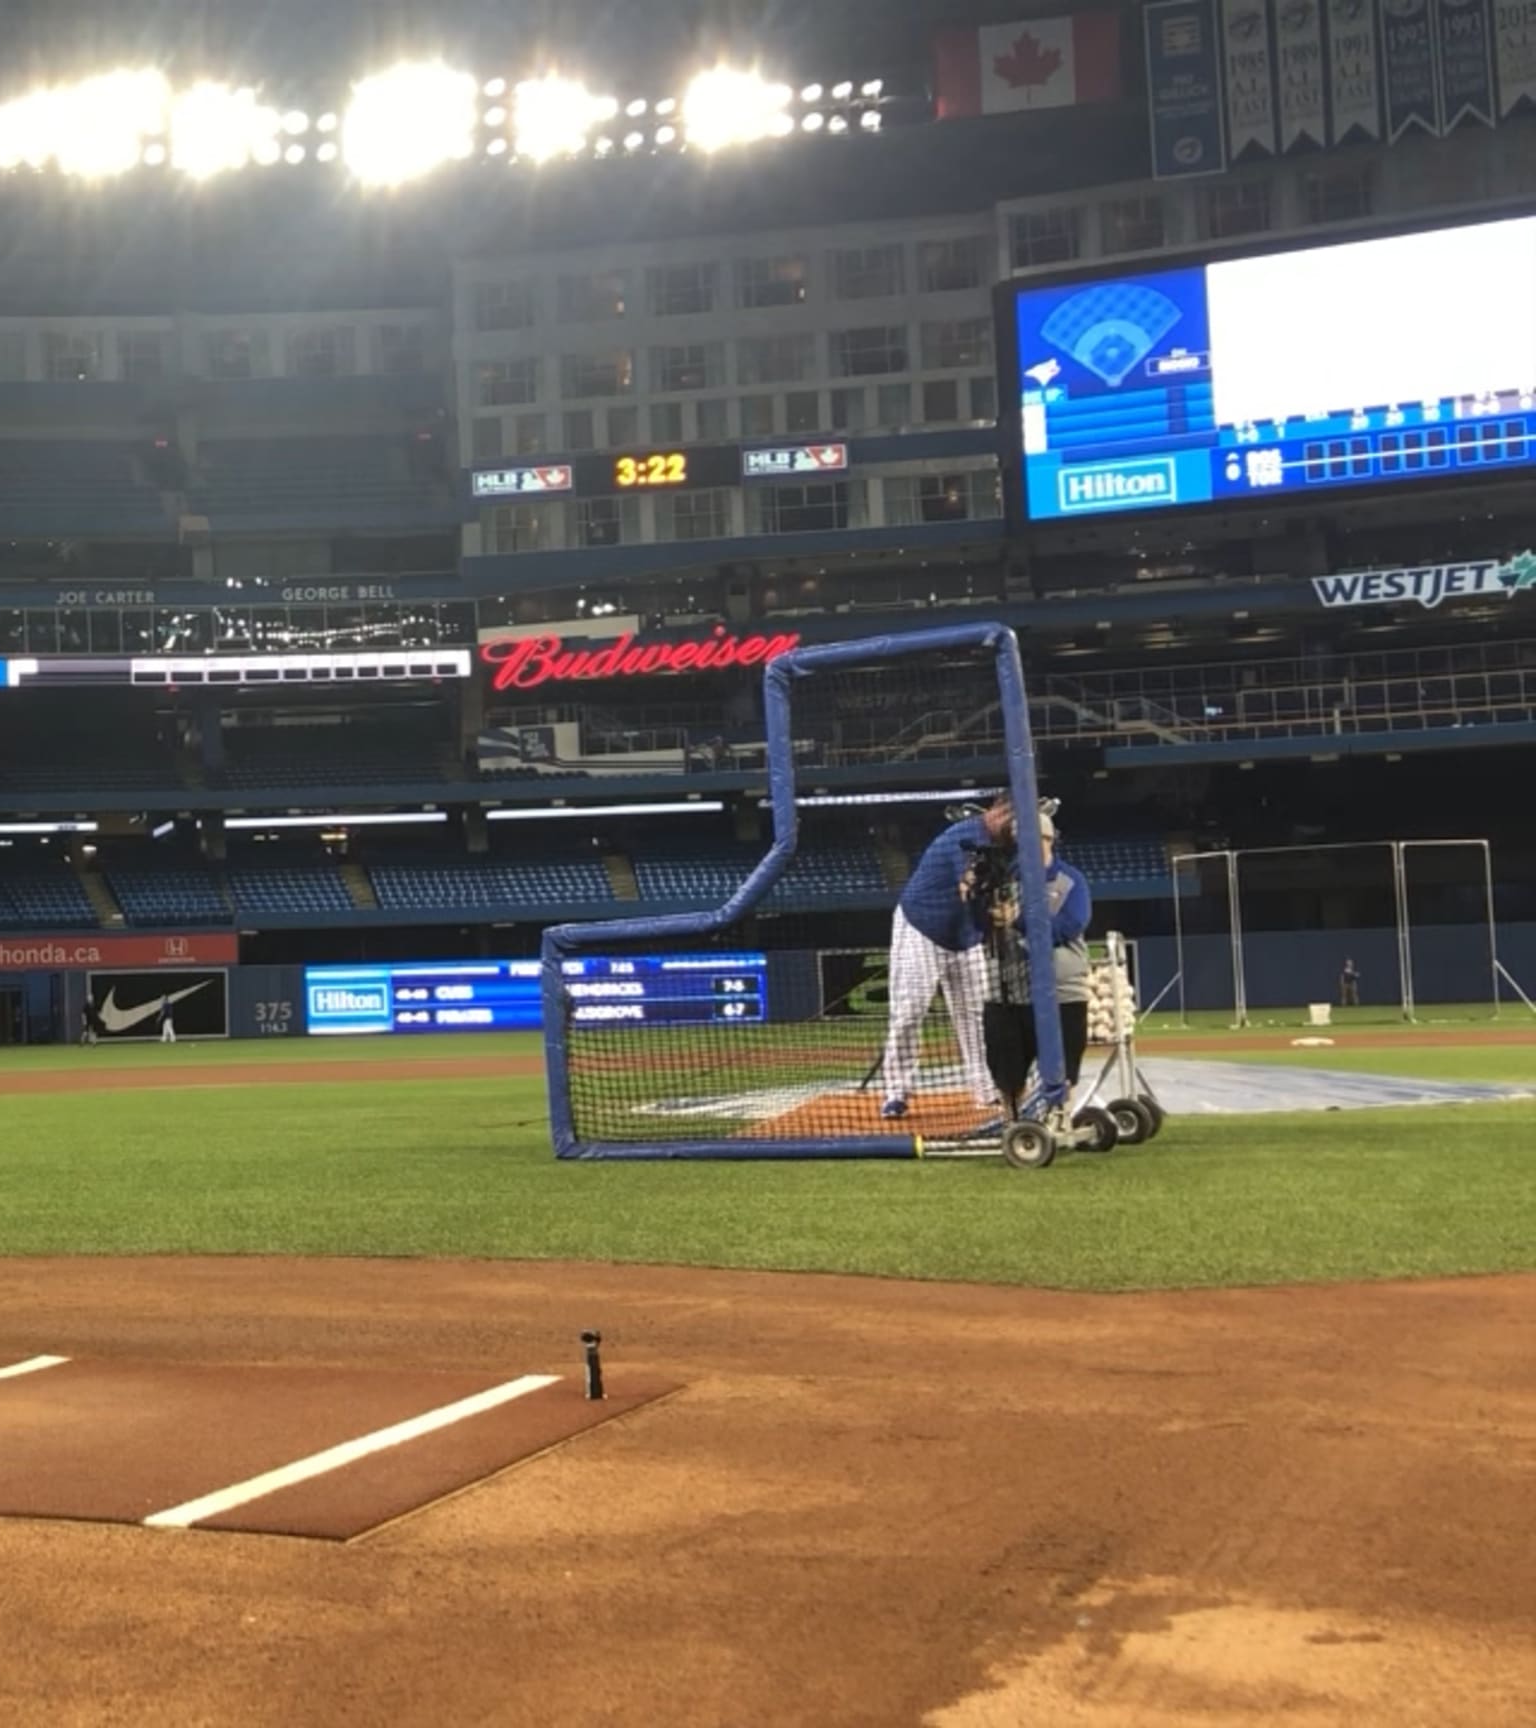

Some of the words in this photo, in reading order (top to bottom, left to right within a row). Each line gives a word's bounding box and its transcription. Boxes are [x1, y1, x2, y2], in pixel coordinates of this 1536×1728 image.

[747, 450, 790, 467] MLB
[476, 471, 517, 488] MLB
[615, 454, 686, 487] 3:22
[1068, 471, 1168, 502] Hilton
[281, 586, 349, 601] GEORGE
[357, 584, 394, 599] BELL
[1316, 562, 1496, 604] WESTJET
[56, 590, 86, 605] JOE
[95, 590, 155, 604] CARTER
[480, 625, 801, 691] Budweiser
[0, 943, 101, 966] honda.ca
[255, 1001, 293, 1021] 375
[315, 990, 382, 1012] Hilton
